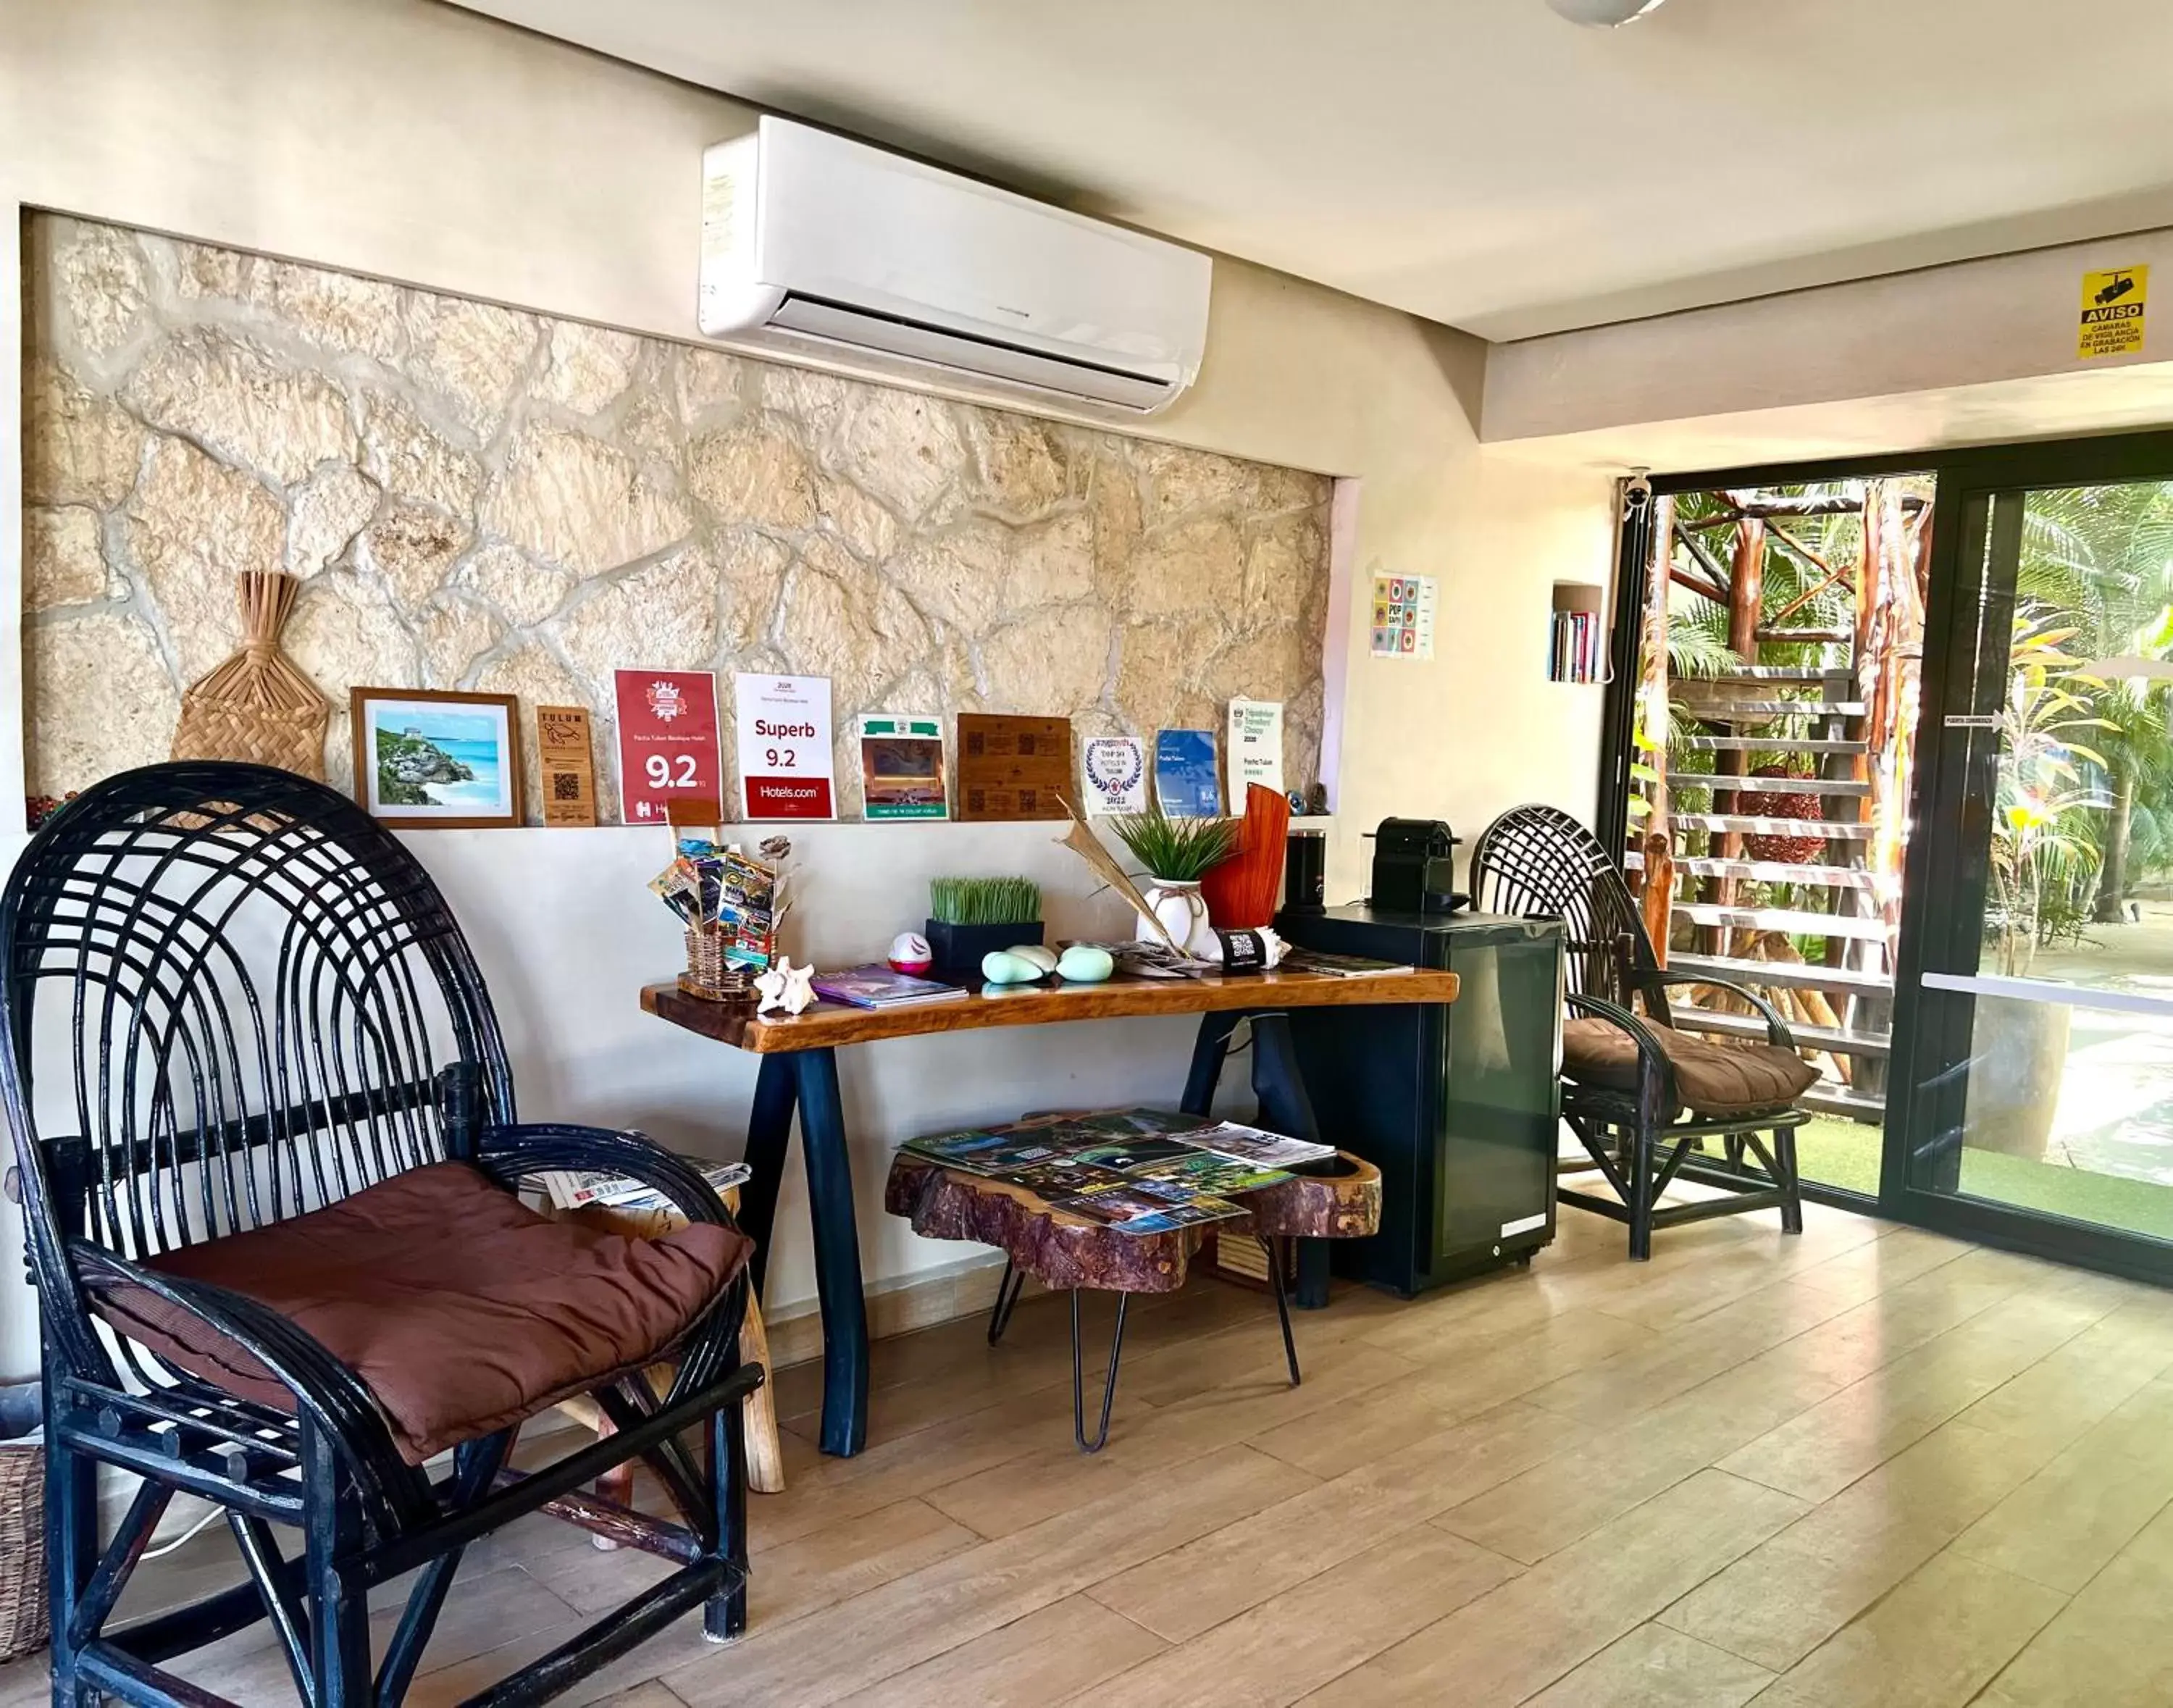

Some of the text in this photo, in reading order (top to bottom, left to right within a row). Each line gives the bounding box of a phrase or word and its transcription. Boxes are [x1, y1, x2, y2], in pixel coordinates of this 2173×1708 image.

[2085, 305, 2140, 322] AVISO
[2082, 332, 2093, 341] DE
[541, 713, 582, 723] TULUM
[755, 719, 816, 740] Superb
[766, 748, 797, 768] 9.2
[645, 754, 698, 789] 9.2
[760, 786, 817, 798] Hotels.com
